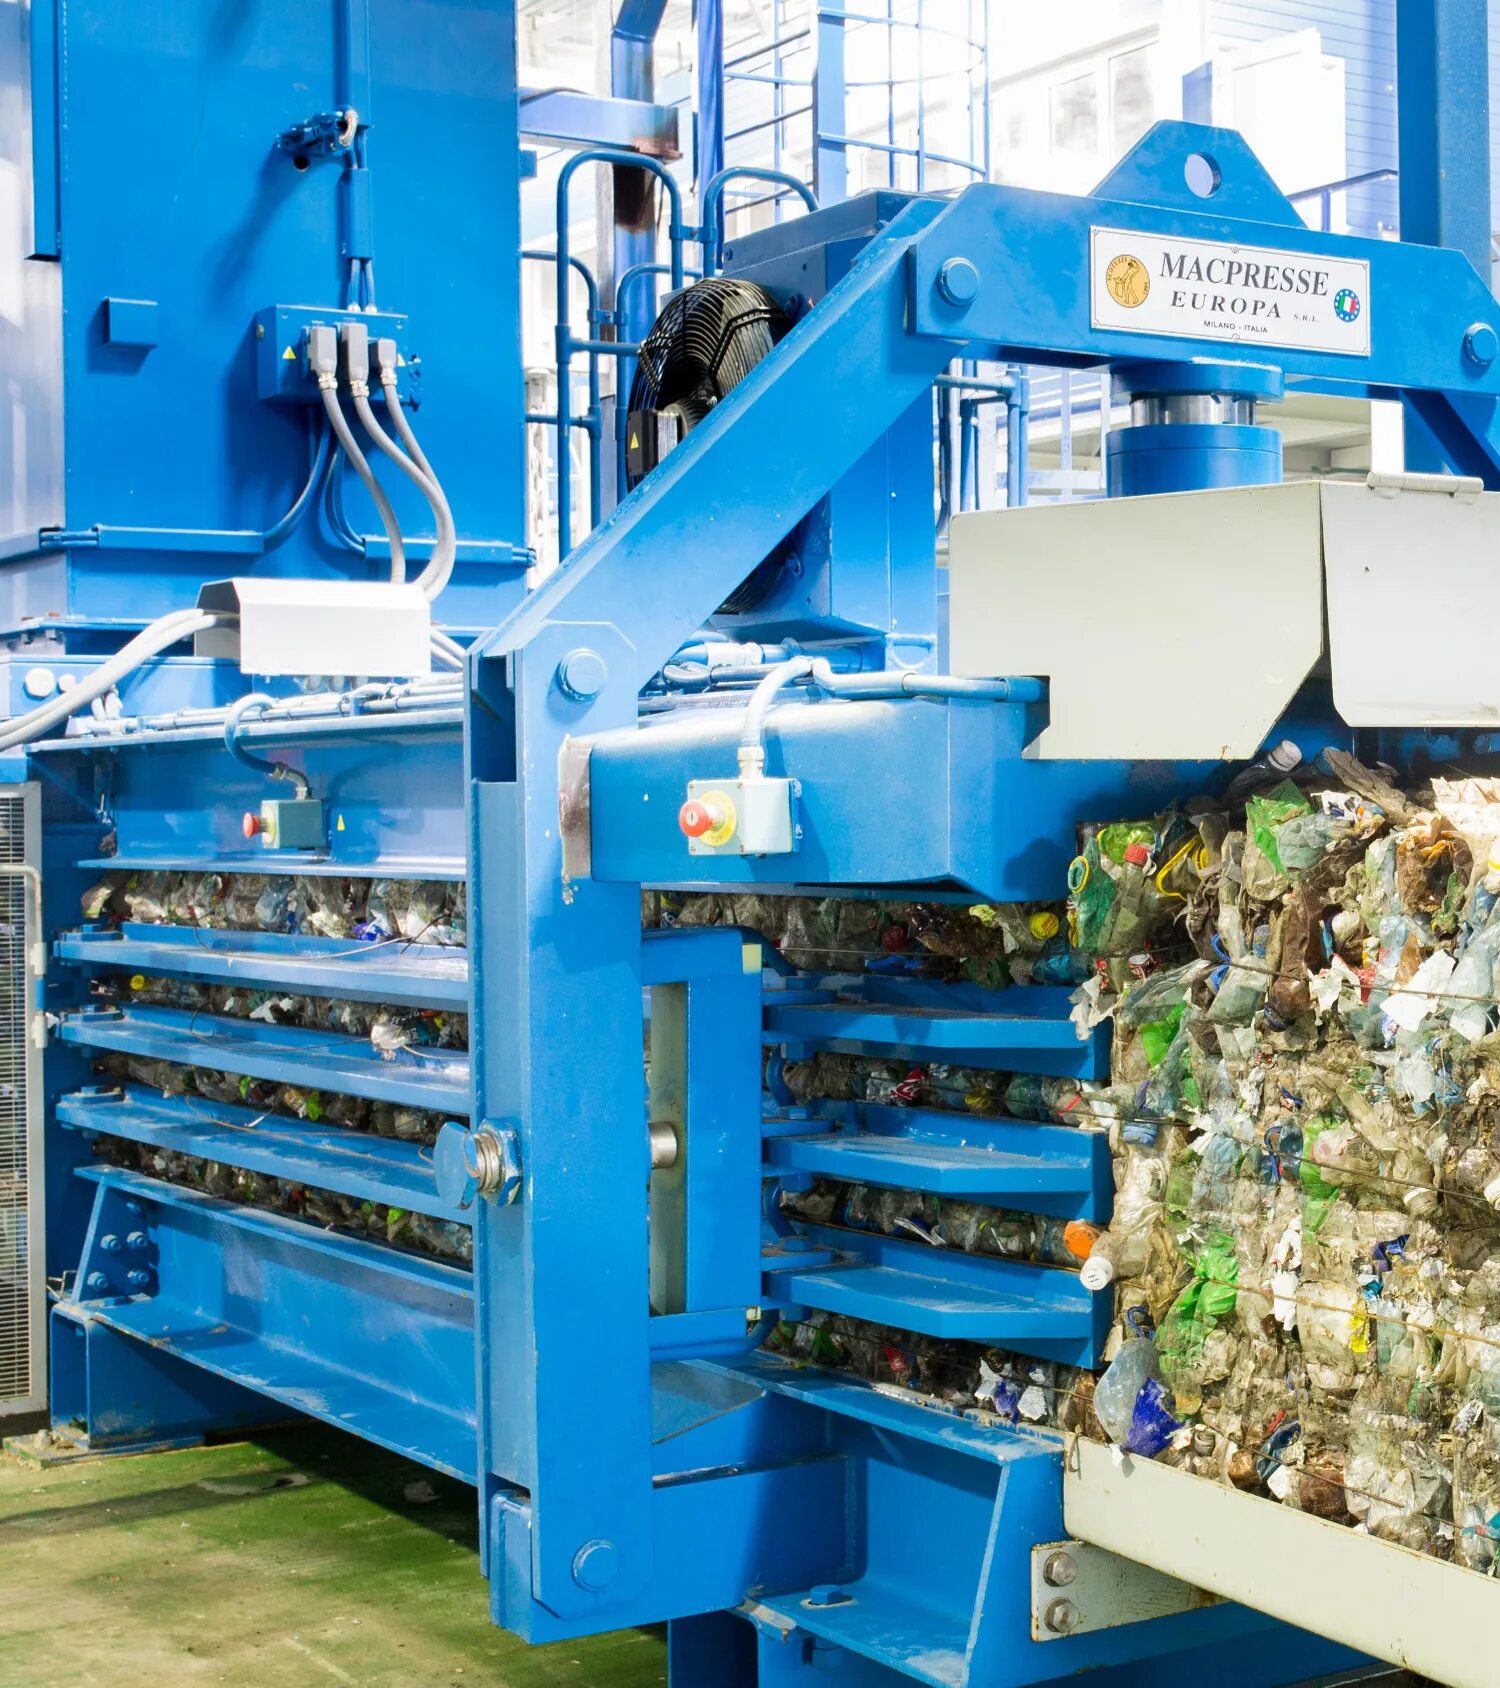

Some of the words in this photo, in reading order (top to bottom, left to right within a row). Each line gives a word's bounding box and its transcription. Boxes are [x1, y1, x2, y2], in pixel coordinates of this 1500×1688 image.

[1160, 252, 1329, 297] MACPRESSE
[1170, 290, 1282, 319] EUROPA
[1293, 312, 1321, 323] S.R.L.
[1203, 320, 1236, 331] MILANO
[1244, 324, 1268, 334] ITALIA
